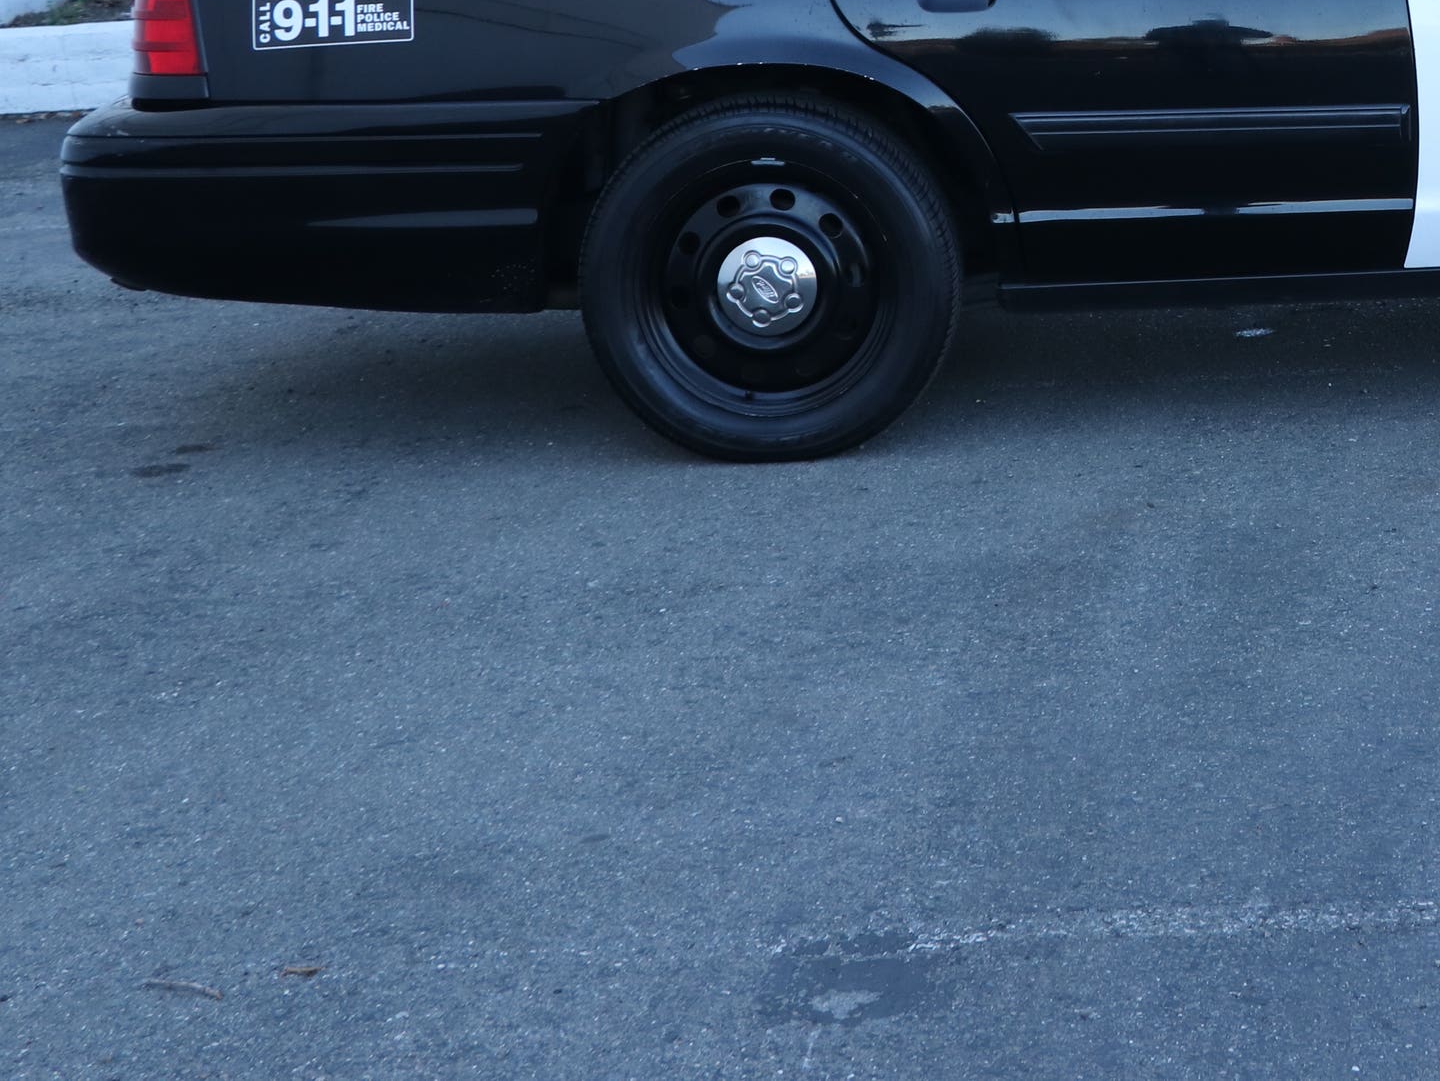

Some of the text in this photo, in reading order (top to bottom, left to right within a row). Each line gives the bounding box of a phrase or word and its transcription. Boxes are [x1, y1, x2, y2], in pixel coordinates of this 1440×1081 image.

[356, 3, 384, 14] FIRE
[259, 2, 272, 43] CALL
[356, 12, 400, 23] POLICE
[356, 20, 411, 33] MEDICAL
